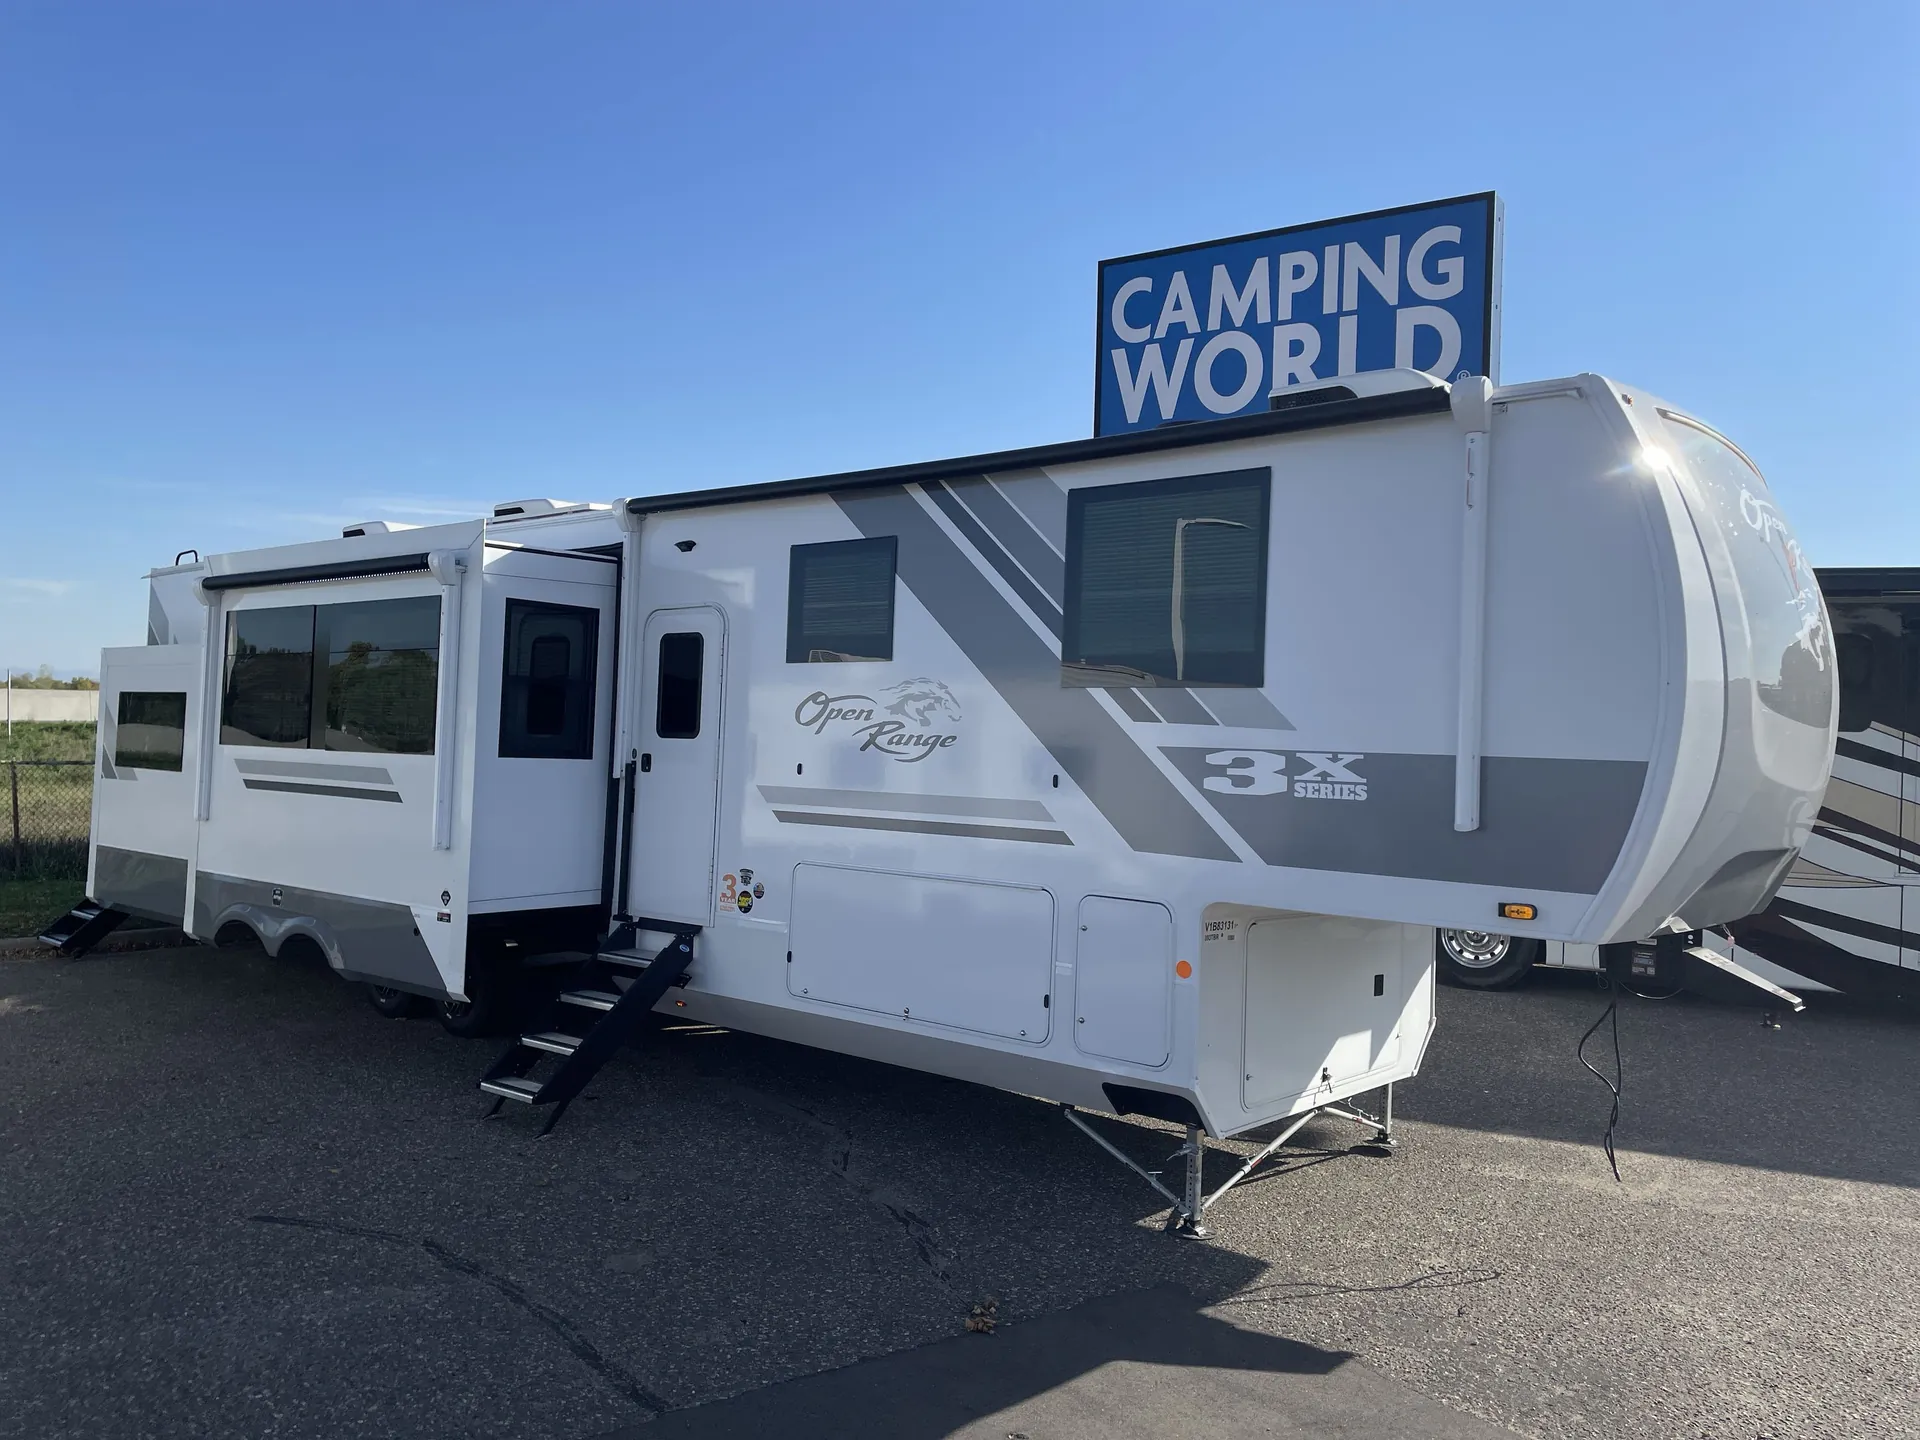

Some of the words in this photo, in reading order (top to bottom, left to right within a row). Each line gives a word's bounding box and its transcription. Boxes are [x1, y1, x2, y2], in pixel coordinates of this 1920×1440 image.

[1111, 225, 1464, 343] CAMPING
[795, 690, 878, 735] Open
[851, 720, 958, 763] Range
[1293, 782, 1368, 801] SERIES
[721, 873, 737, 899] 3
